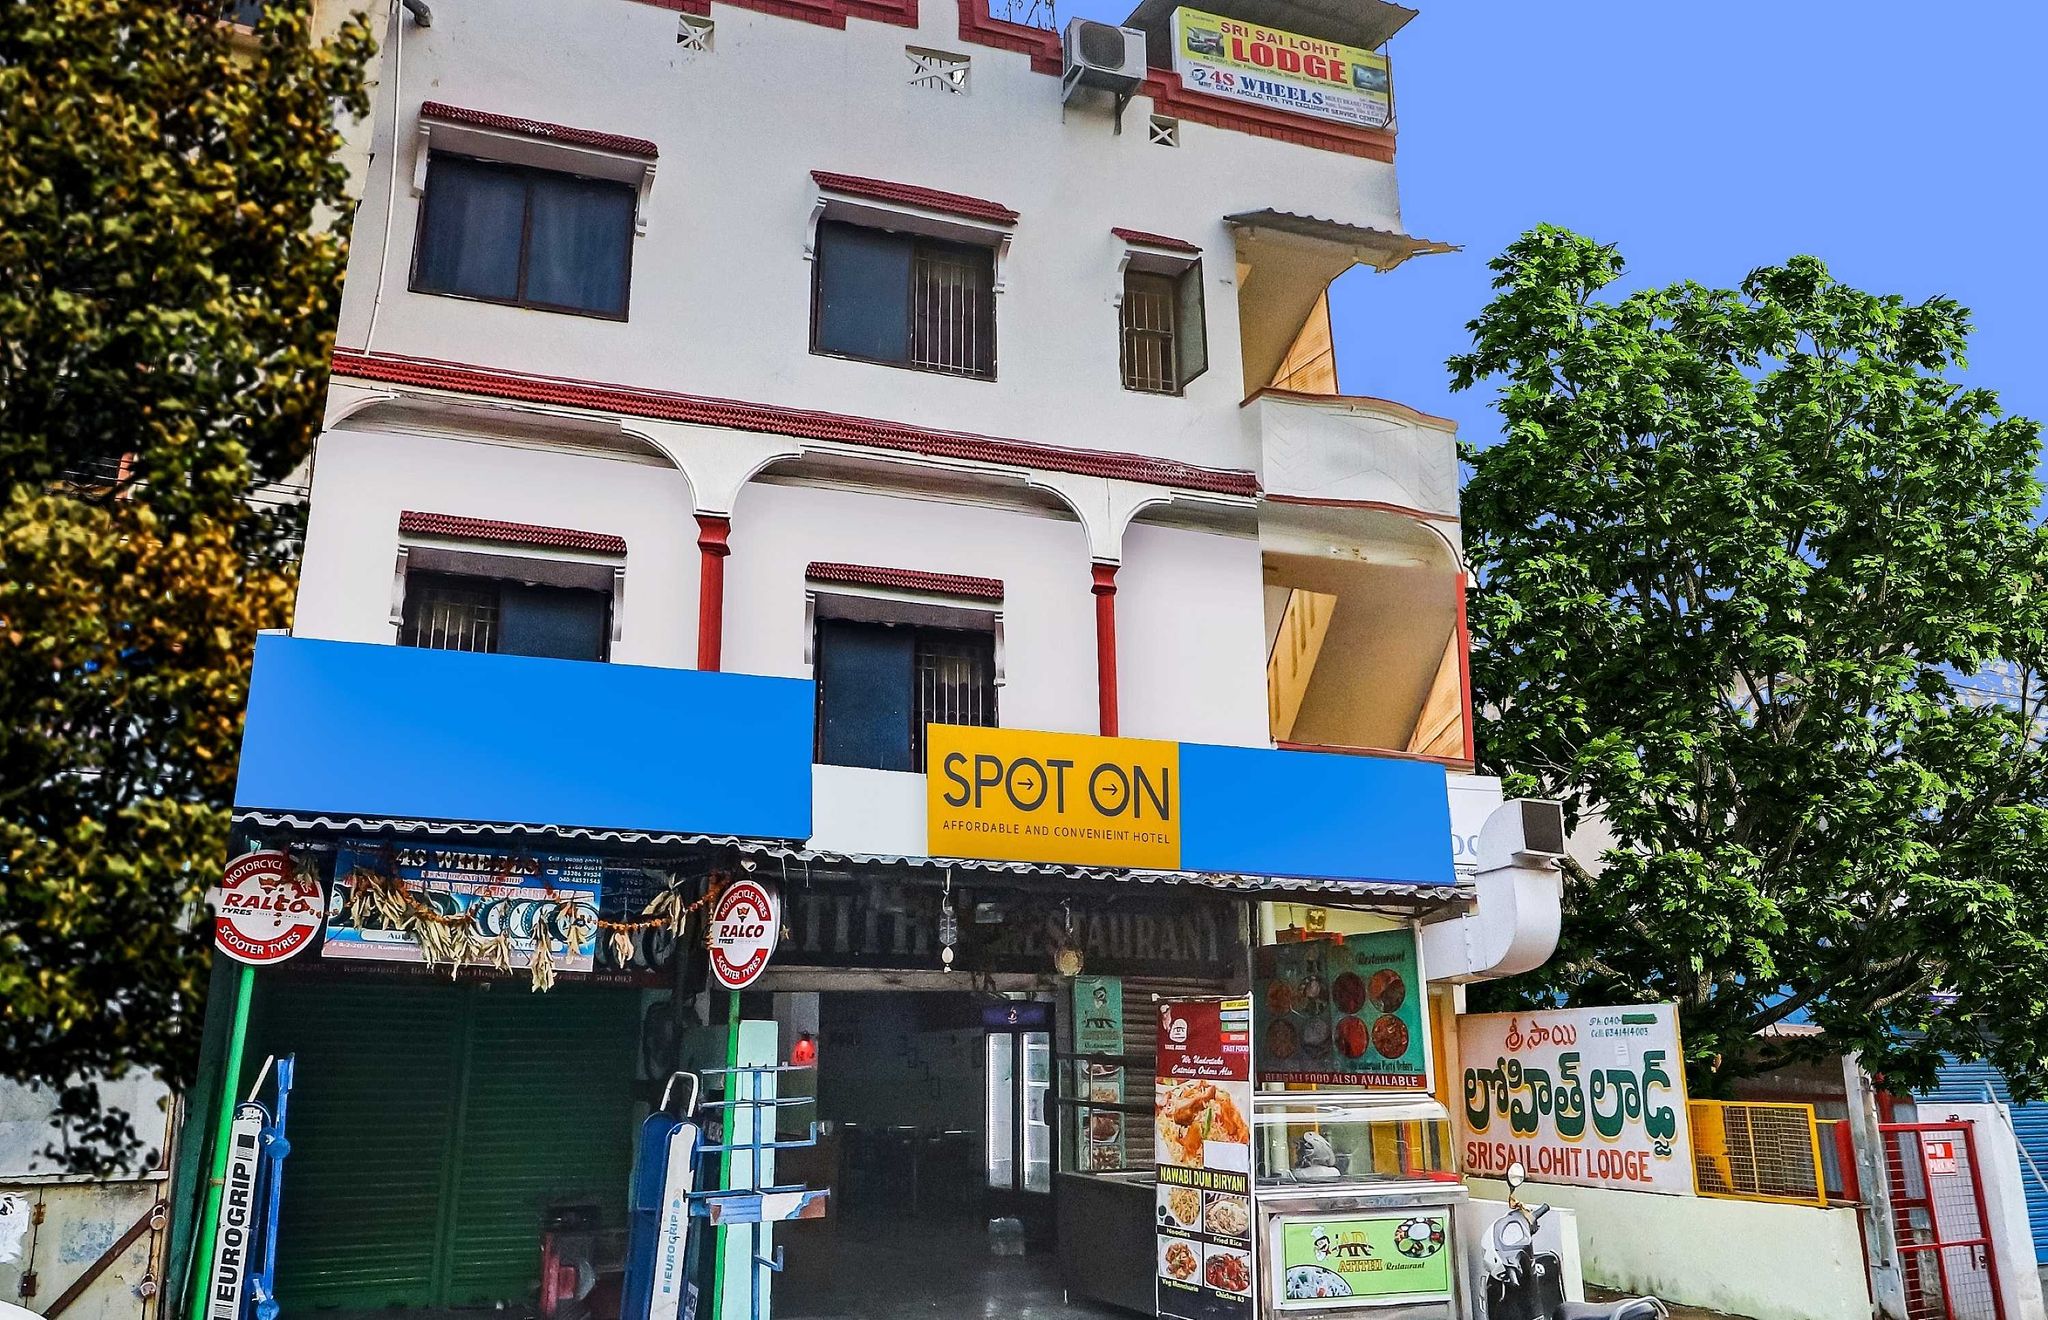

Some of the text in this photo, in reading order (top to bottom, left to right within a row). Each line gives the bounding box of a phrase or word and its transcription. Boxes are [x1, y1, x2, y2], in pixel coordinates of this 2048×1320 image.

[1221, 21, 1249, 38] SRI
[1255, 30, 1284, 46] SAI
[1290, 35, 1340, 58] LOHIT
[1232, 37, 1348, 85] LODGE
[1210, 71, 1235, 87] 4S
[1240, 76, 1324, 105] WHEELS
[1295, 101, 1330, 113] EXCLUSIVE
[1331, 107, 1358, 118] SERVICE
[943, 752, 1170, 821] SPOT ON
[943, 820, 1020, 835] AFFORDABLE
[1025, 825, 1049, 836] AND
[1133, 832, 1171, 844] HOTEL
[225, 859, 283, 886] MOTORCYCL
[221, 907, 253, 916] TYRES
[754, 894, 769, 918] TYRES
[218, 925, 301, 955] SCOOTER TYRES
[720, 924, 765, 938] RALCO
[716, 955, 761, 980] SCOOTER TYRES
[1527, 1020, 1577, 1050] సాయి
[1304, 1073, 1330, 1085] FOOD
[1332, 1074, 1358, 1085] ALSO
[1360, 1075, 1419, 1088] AVAILABLE
[1466, 1141, 1653, 1183] SRI SAI LOHIT LODGE
[1160, 1166, 1246, 1193] NAWABI DUM BIRYANI
[216, 1162, 254, 1303] EUROGRIP
[663, 1213, 682, 1278] EUROGRIP
[1166, 1228, 1191, 1238] Noodles
[1213, 1236, 1242, 1247] Fried Rice
[1337, 1259, 1425, 1273] ATITHI Restaurant
[1215, 1290, 1237, 1301] Chicken
